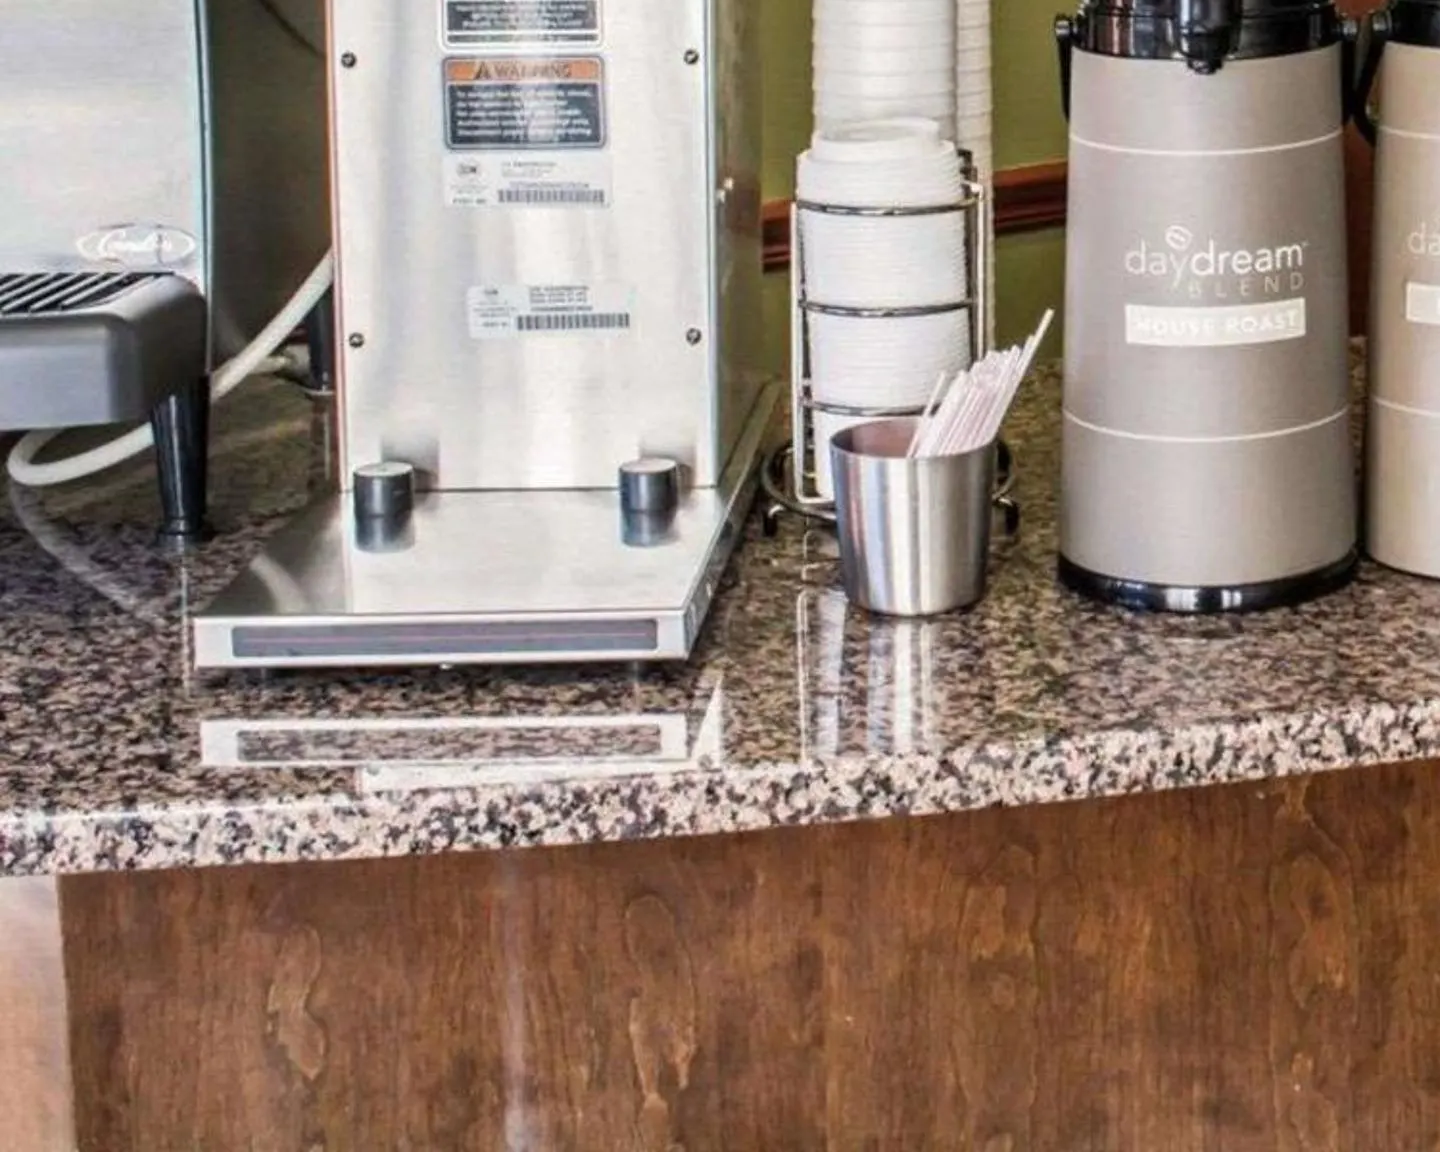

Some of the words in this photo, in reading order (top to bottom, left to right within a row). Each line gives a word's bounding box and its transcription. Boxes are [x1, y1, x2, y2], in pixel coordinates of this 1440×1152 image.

[1125, 238, 1304, 288] daydream
[1188, 272, 1305, 297] BLEND
[1136, 316, 1216, 338] HOUSE
[1226, 308, 1301, 335] ROAST
